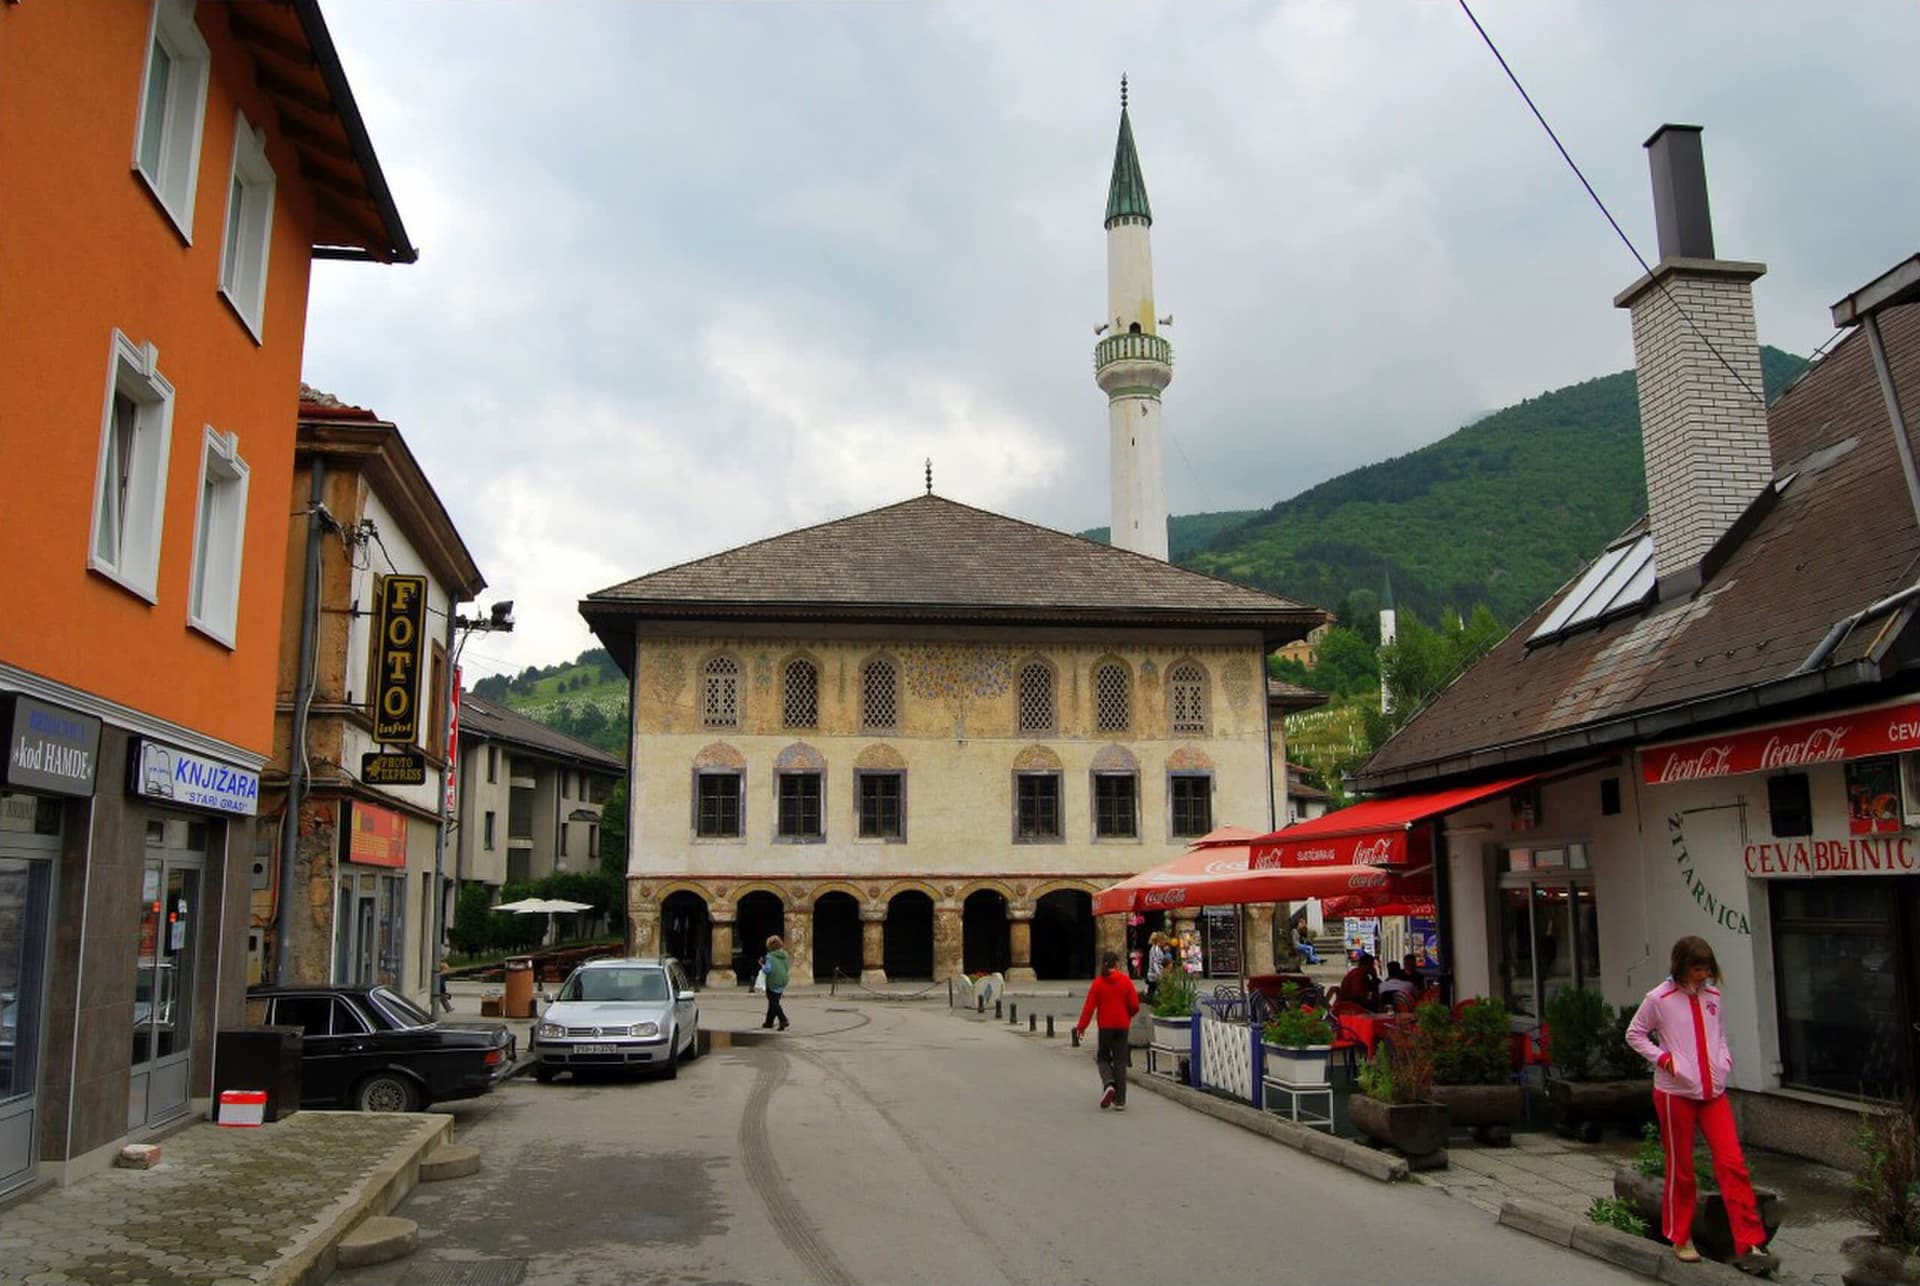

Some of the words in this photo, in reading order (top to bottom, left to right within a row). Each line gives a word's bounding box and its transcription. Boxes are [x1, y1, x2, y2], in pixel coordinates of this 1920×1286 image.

[384, 581, 416, 716] FOTO
[1888, 720, 1920, 742] ČEV
[175, 757, 257, 799] KNJIŽARA
